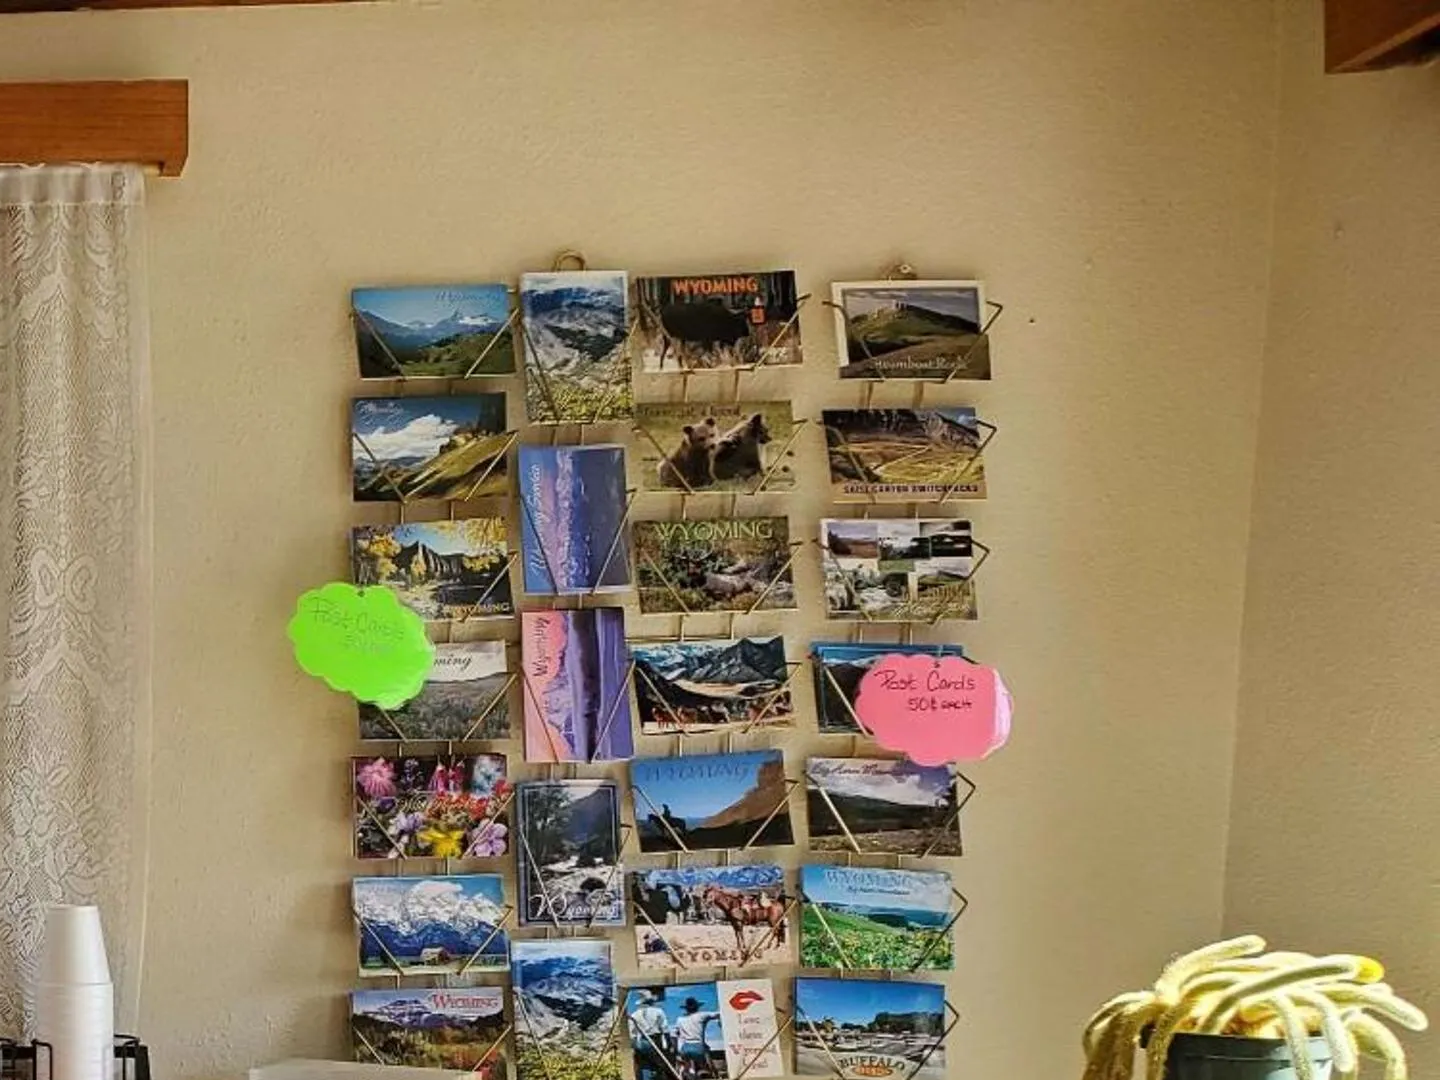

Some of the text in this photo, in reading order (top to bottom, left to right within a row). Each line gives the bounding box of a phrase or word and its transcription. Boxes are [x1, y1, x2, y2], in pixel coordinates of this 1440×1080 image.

[671, 277, 759, 295] WYOMING
[653, 521, 773, 541] WYOMING
[433, 653, 472, 671] ming
[874, 669, 976, 692] Post Cards
[839, 1055, 905, 1071] BUFFALO
